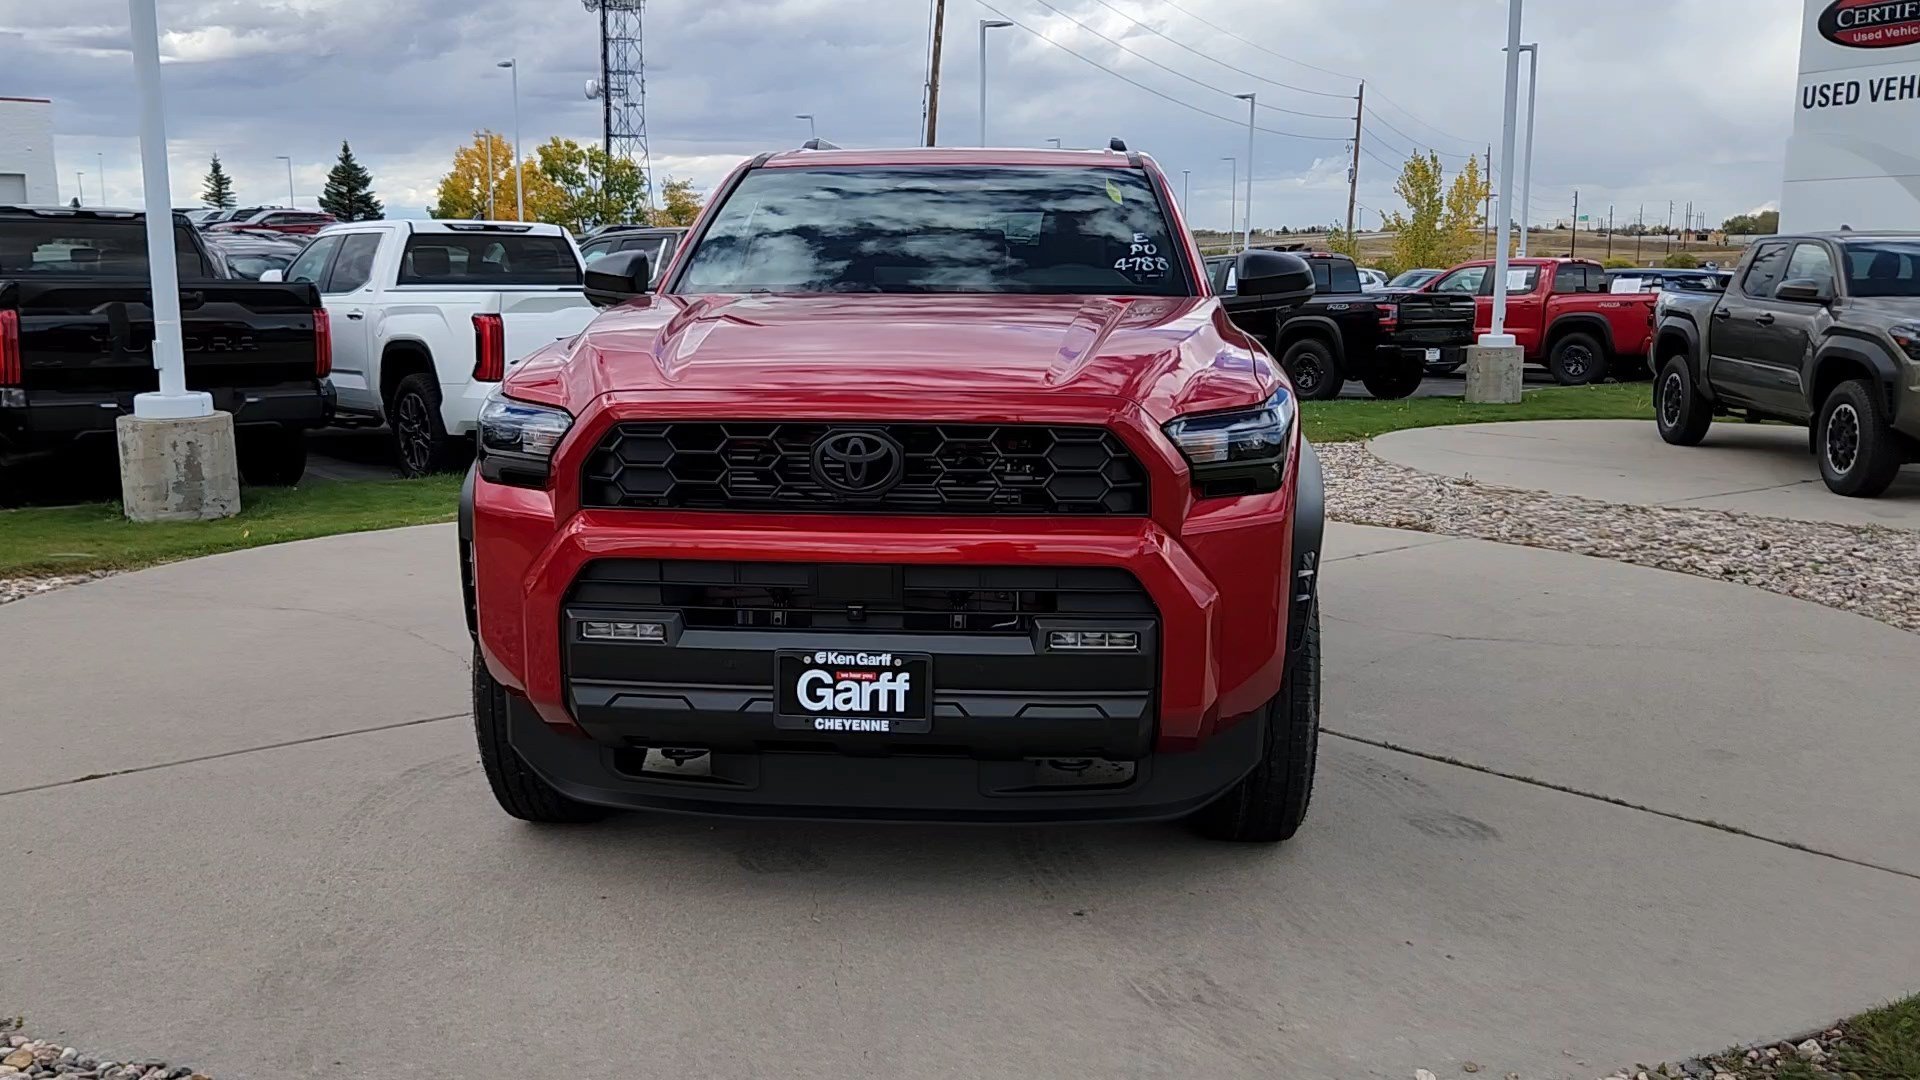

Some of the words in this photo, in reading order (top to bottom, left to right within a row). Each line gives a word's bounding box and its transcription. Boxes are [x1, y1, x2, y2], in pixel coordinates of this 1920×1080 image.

[1837, 2, 1920, 28] CERTIF
[1853, 30, 1882, 42] Used
[1885, 24, 1920, 38] Vehic
[1803, 81, 1860, 110] USED
[90, 335, 259, 353] TUDRA
[828, 652, 855, 665] Ken
[856, 652, 891, 666] Garff
[797, 669, 910, 712] Garff
[815, 718, 889, 732] CHEYENNE
